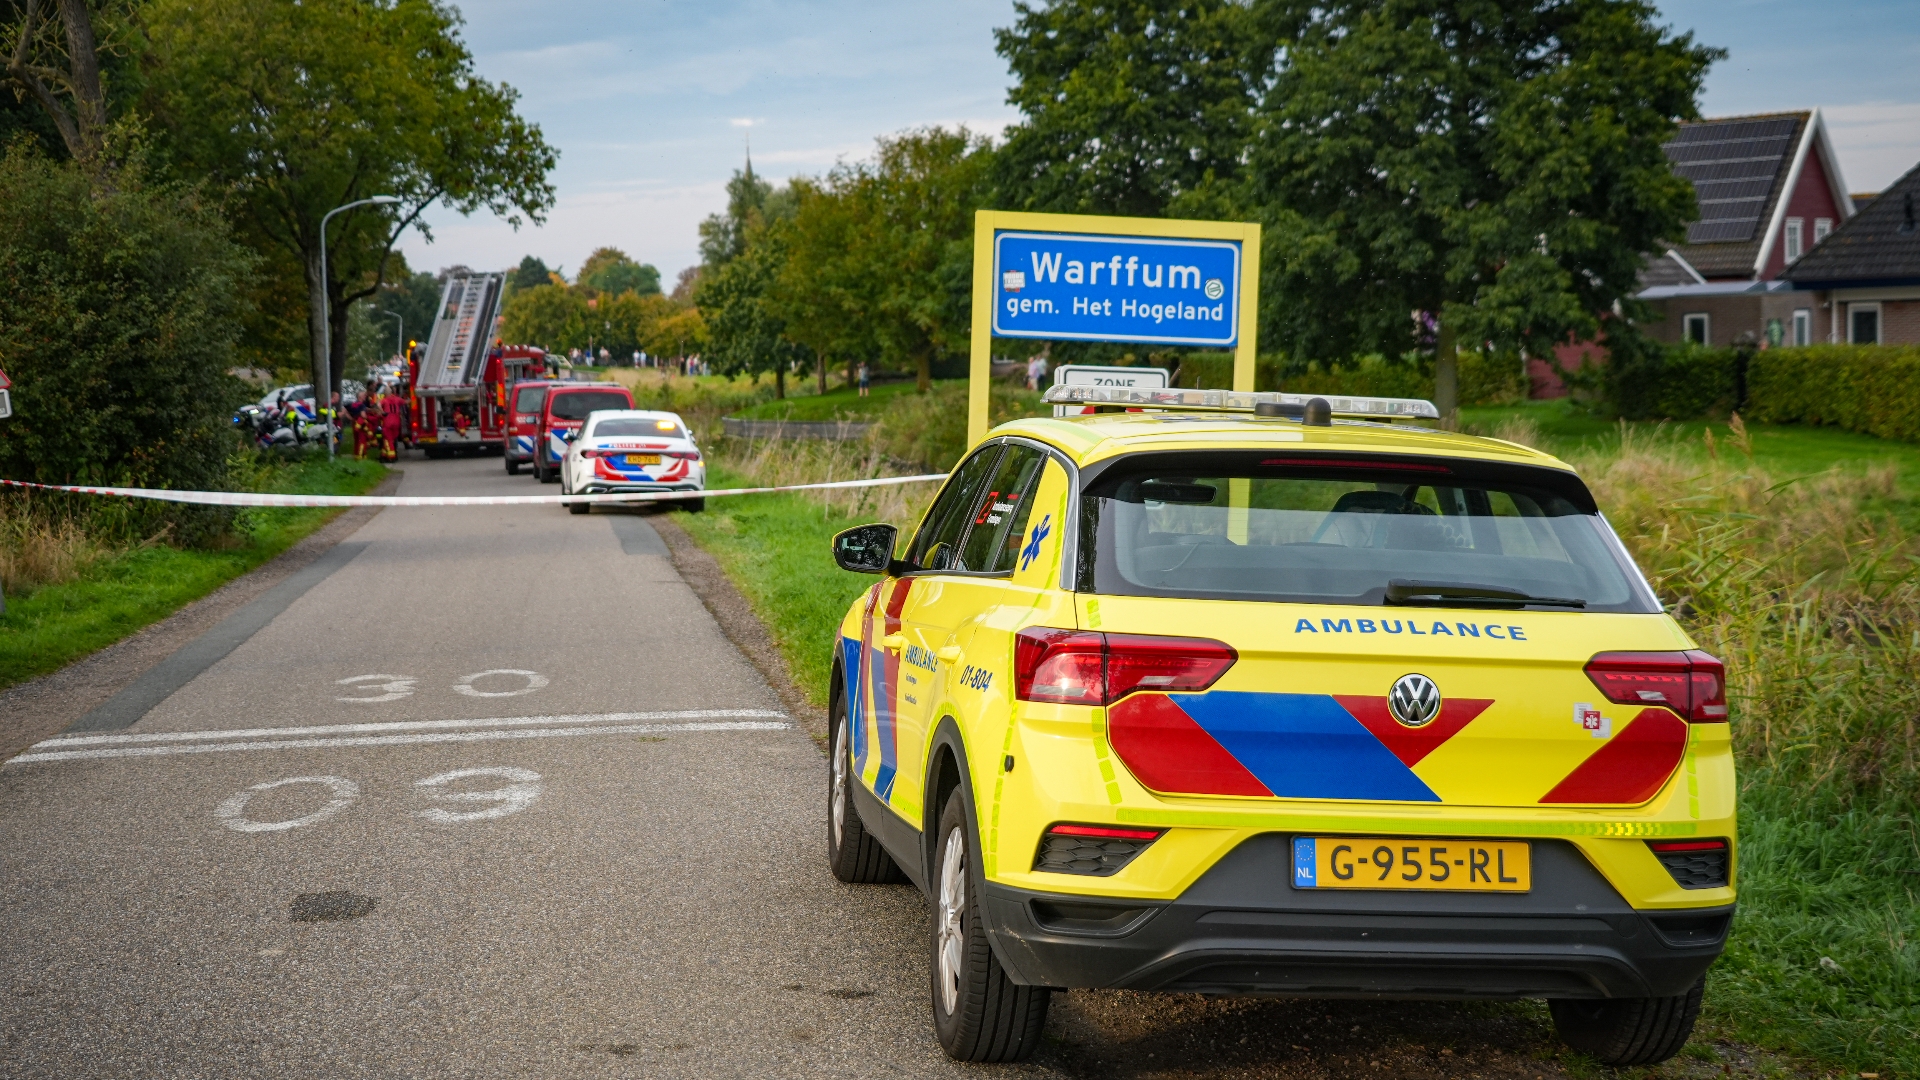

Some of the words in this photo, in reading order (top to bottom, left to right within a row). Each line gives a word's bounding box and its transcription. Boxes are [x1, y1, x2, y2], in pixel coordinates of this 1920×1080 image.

[1031, 251, 1201, 289] Warffum
[1006, 298, 1060, 318] gem.
[1073, 297, 1112, 317] Het
[1121, 299, 1223, 324] Hogeland
[1294, 618, 1528, 641] AMBULANCE
[335, 669, 549, 702] 30
[960, 665, 993, 692] 01-804
[1297, 867, 1313, 879] NL
[1330, 845, 1518, 884] G-955-RL
